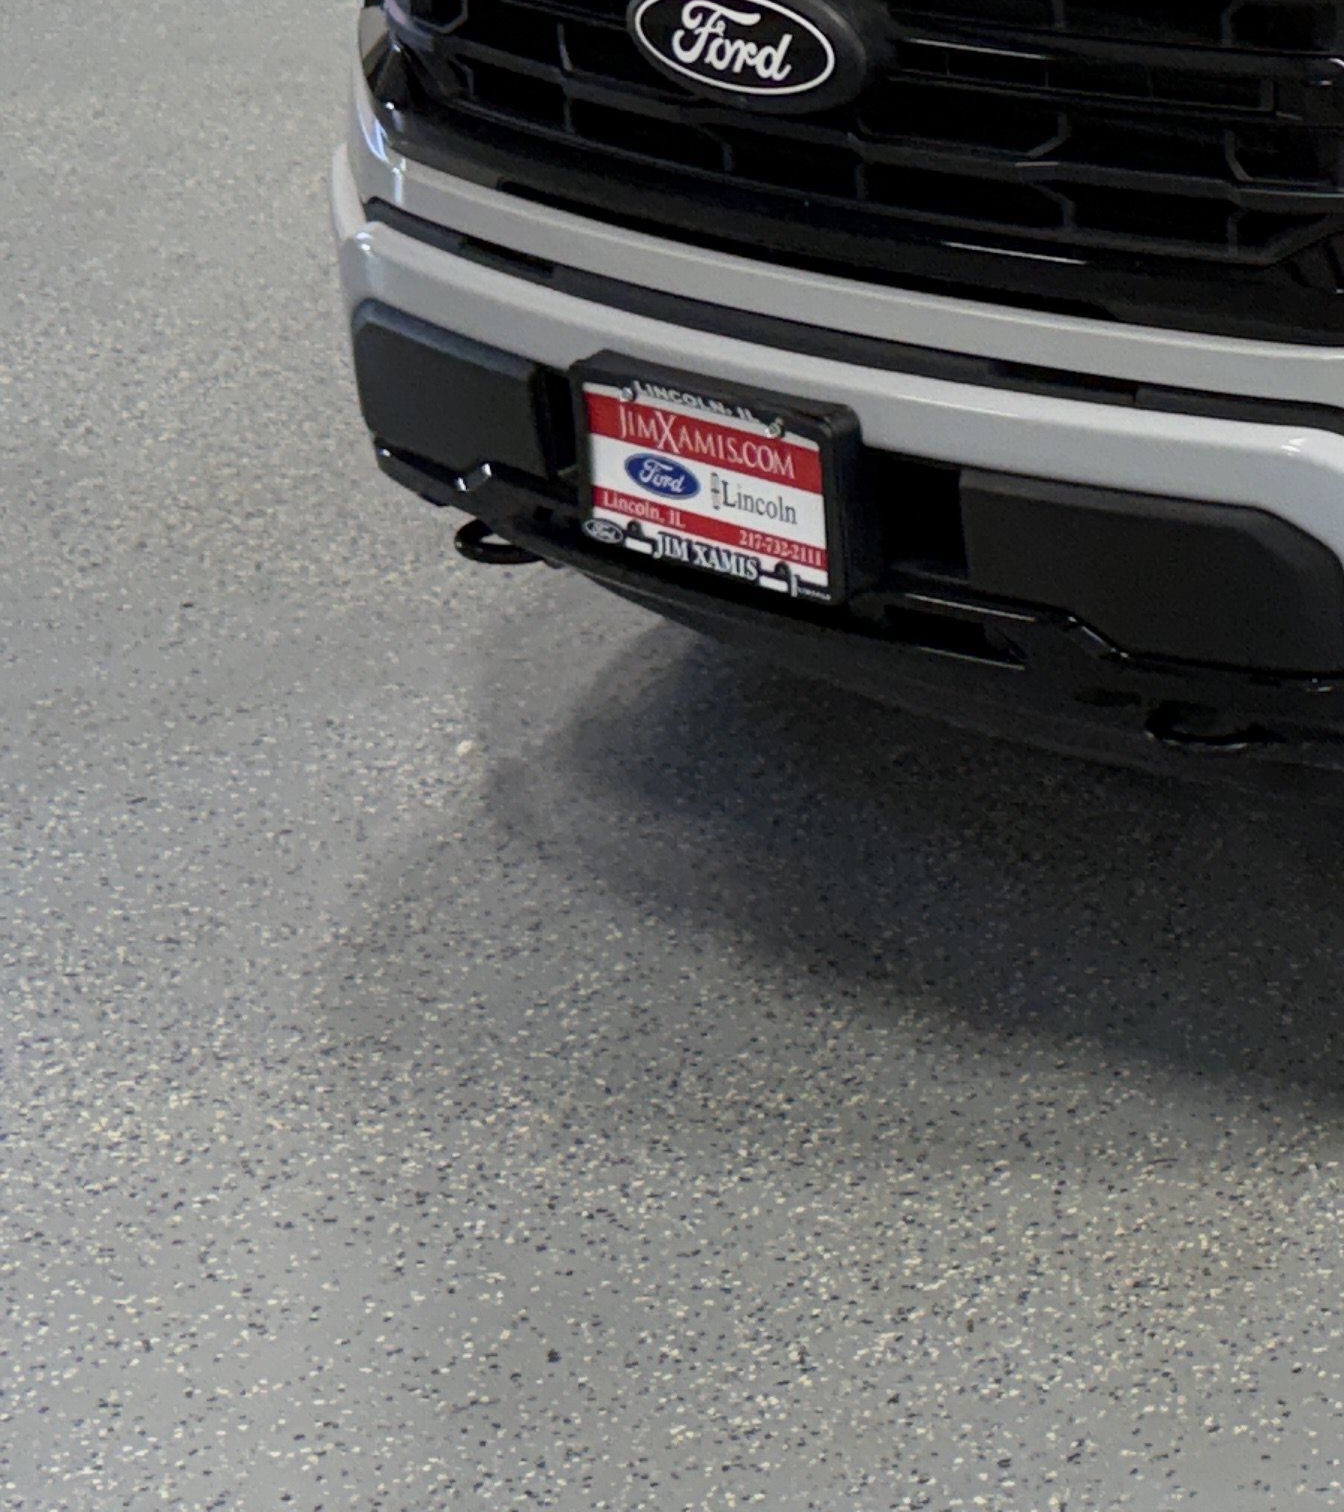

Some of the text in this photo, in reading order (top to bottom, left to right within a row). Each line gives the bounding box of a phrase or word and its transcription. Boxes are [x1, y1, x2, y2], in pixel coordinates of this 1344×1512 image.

[672, 0, 793, 81] Ford
[617, 403, 795, 480] JIMXAMIS.COM
[637, 458, 686, 494] Ford
[722, 479, 798, 526] Lincoln
[653, 531, 760, 581] JIM XAMIS
